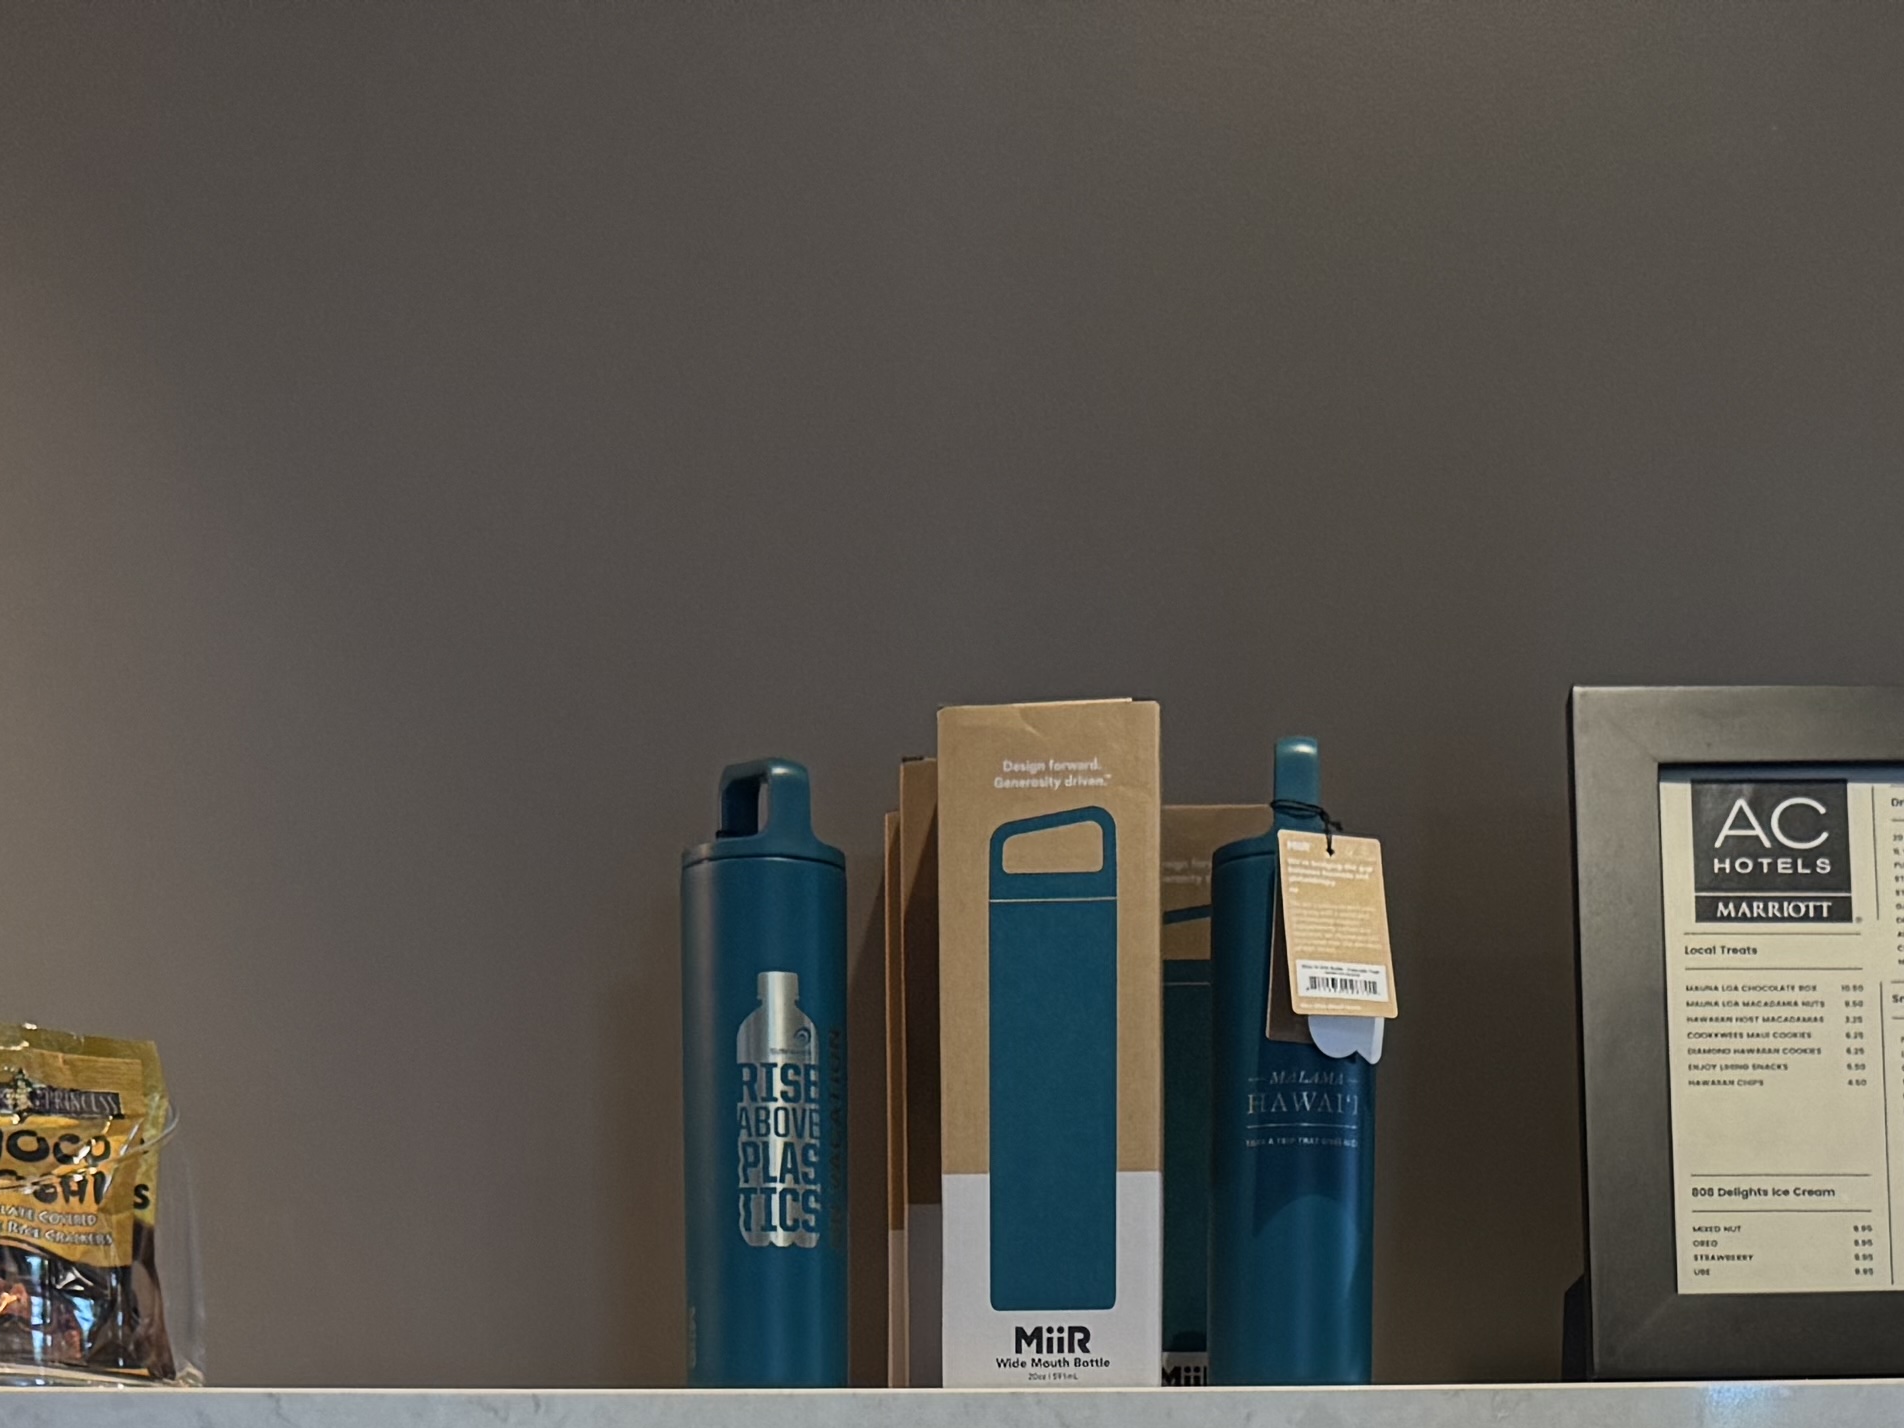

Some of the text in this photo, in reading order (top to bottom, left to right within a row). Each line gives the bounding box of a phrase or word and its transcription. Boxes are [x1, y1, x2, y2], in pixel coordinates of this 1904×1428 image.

[1002, 760, 1045, 774] Design
[994, 777, 1062, 790] Generosity
[1714, 797, 1829, 849] AC
[1713, 858, 1832, 873] HOTELS
[1716, 901, 1832, 918] MARRIOTT
[1684, 945, 1758, 955] Local Treats
[739, 1062, 820, 1103] RISE
[739, 1106, 821, 1139] ABOVE
[741, 1141, 820, 1185] PLAS
[1691, 1187, 1835, 1200] 808 Delights Ice Cream
[739, 1186, 820, 1233] TICS
[38, 1211, 96, 1226] COVERED
[8, 1221, 40, 1239] RICE
[45, 1229, 113, 1245] CRACKERS
[1015, 1326, 1091, 1354] MiiR
[996, 1357, 1111, 1369] Wide Mouth Bottle
